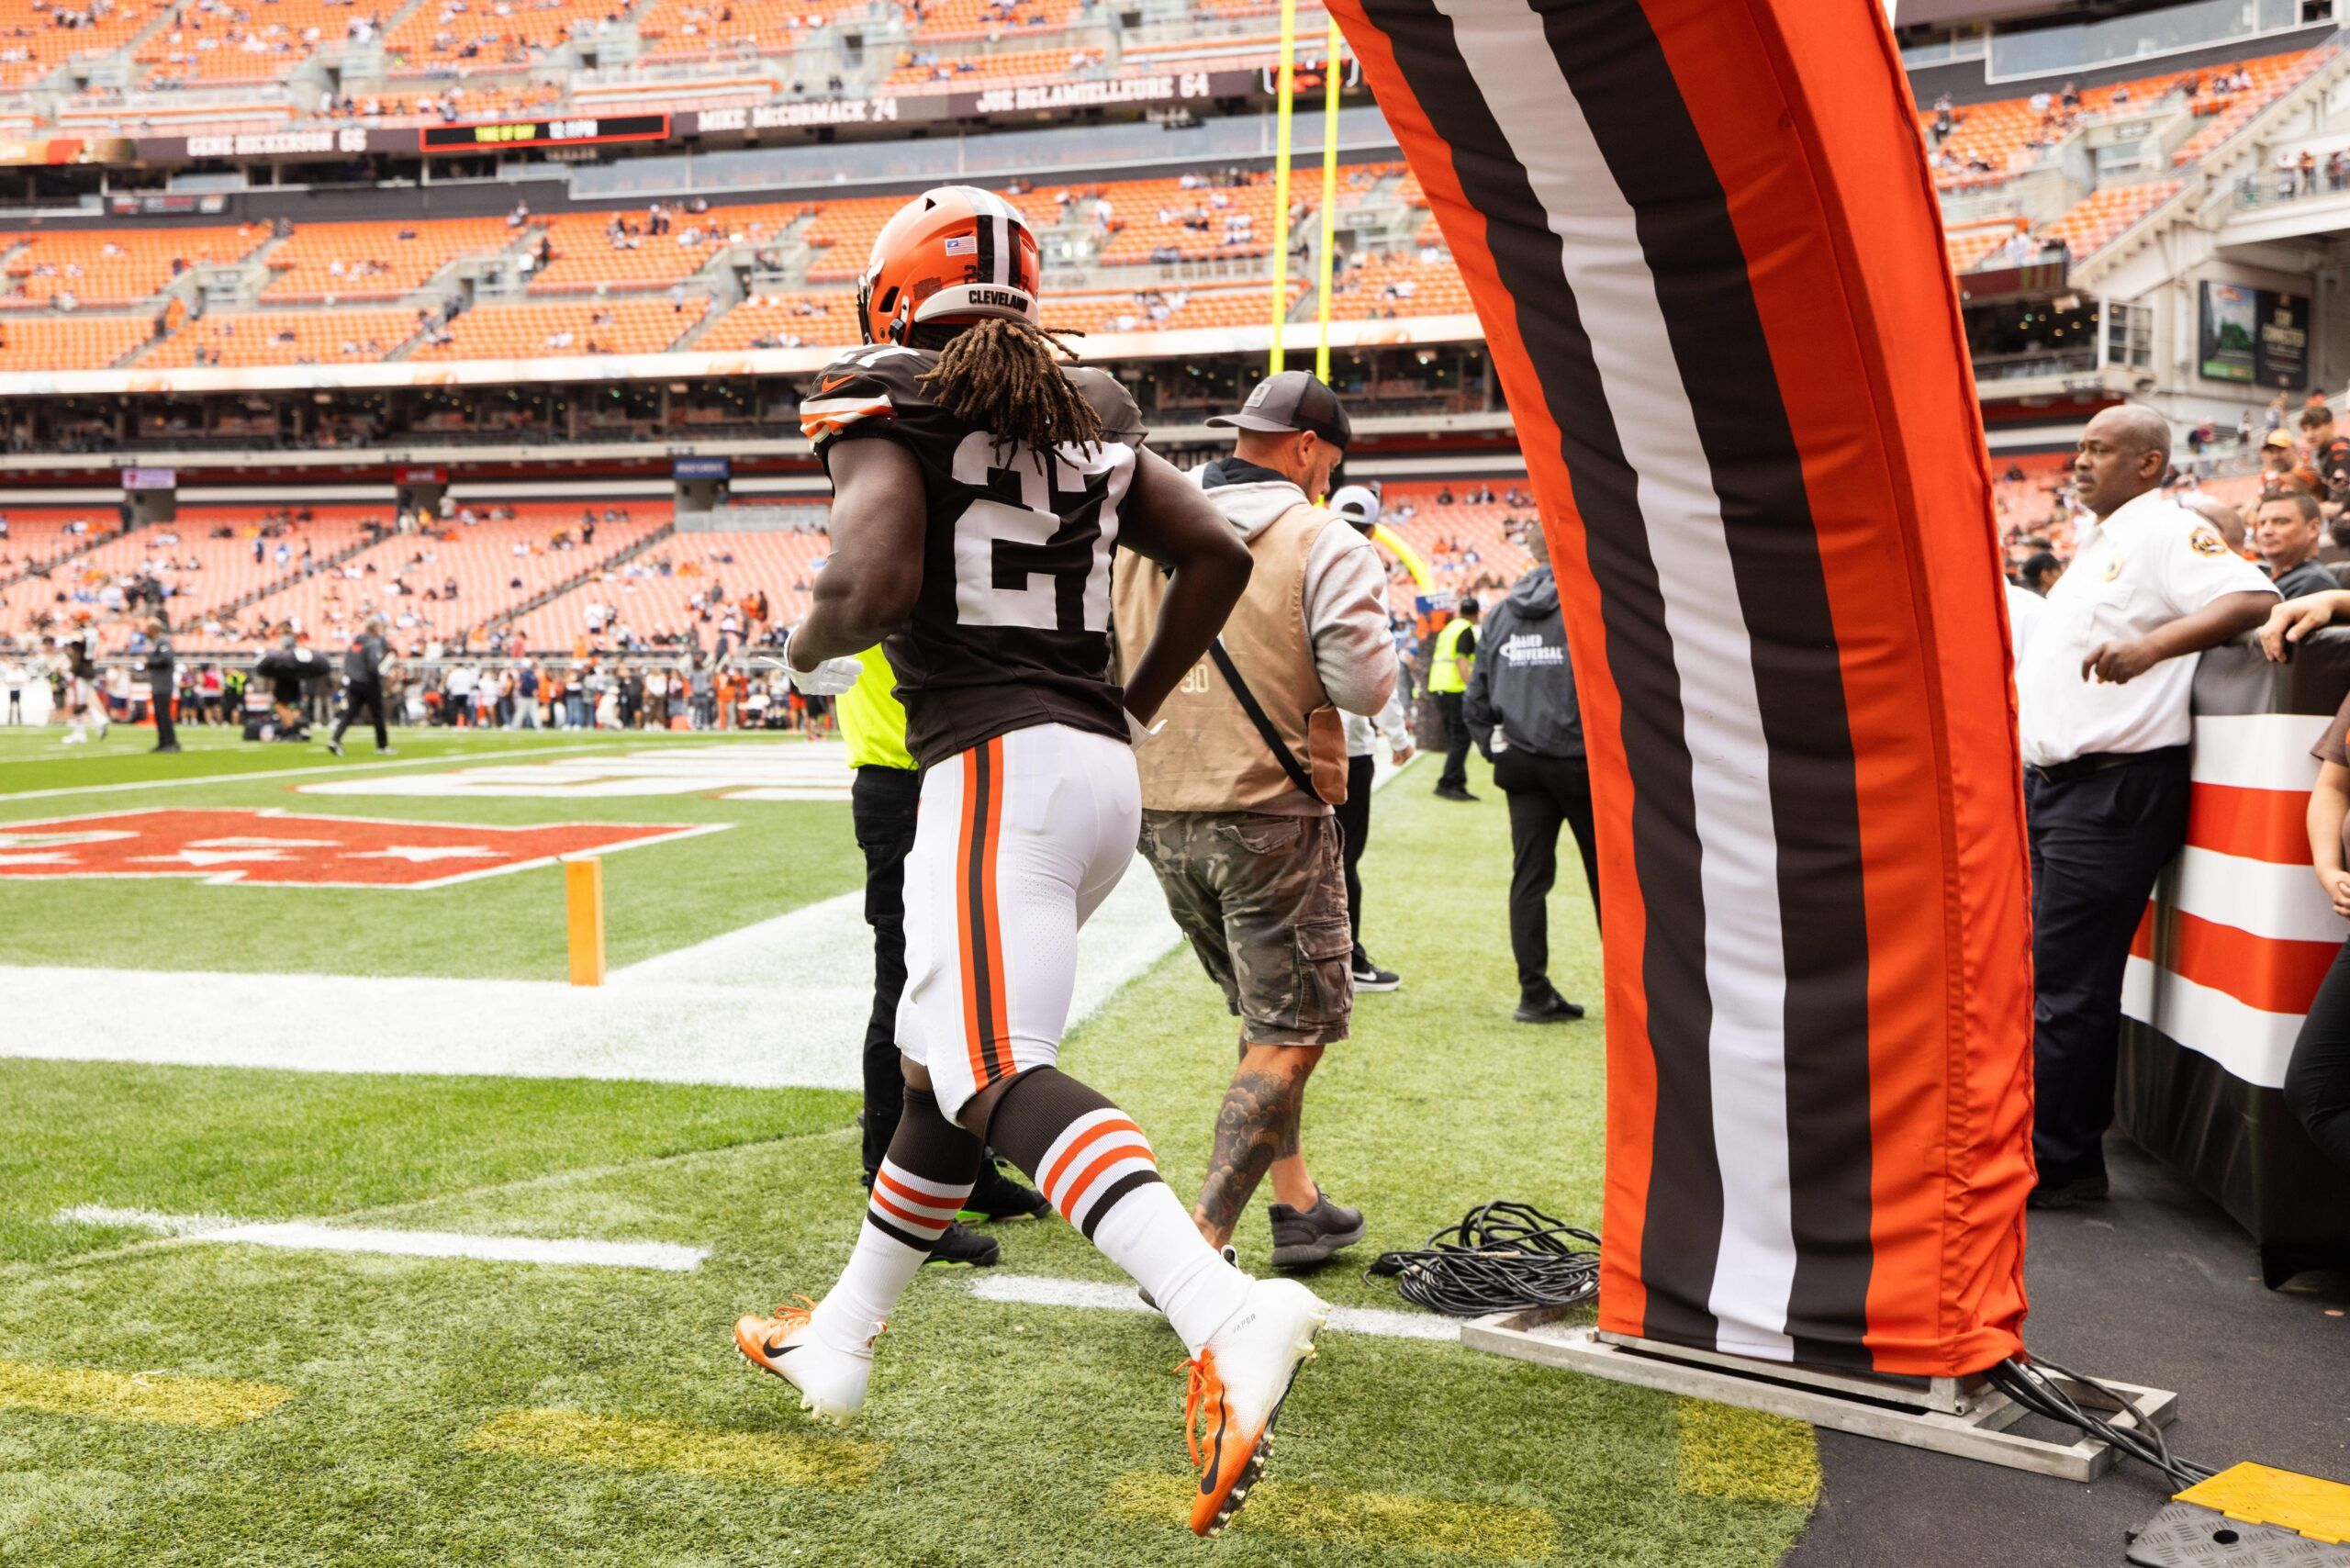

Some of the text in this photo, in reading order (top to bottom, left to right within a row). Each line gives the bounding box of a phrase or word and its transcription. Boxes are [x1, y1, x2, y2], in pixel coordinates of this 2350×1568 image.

[976, 89, 1014, 112] JOE
[1179, 73, 1210, 98] 64
[698, 108, 747, 132] MIKE
[870, 97, 898, 121] 74
[968, 290, 1029, 313] CLEVELAND
[951, 431, 1136, 632] 27
[1509, 646, 1563, 661] UNIVERSAL
[1233, 1313, 1256, 1334] VAPOR
